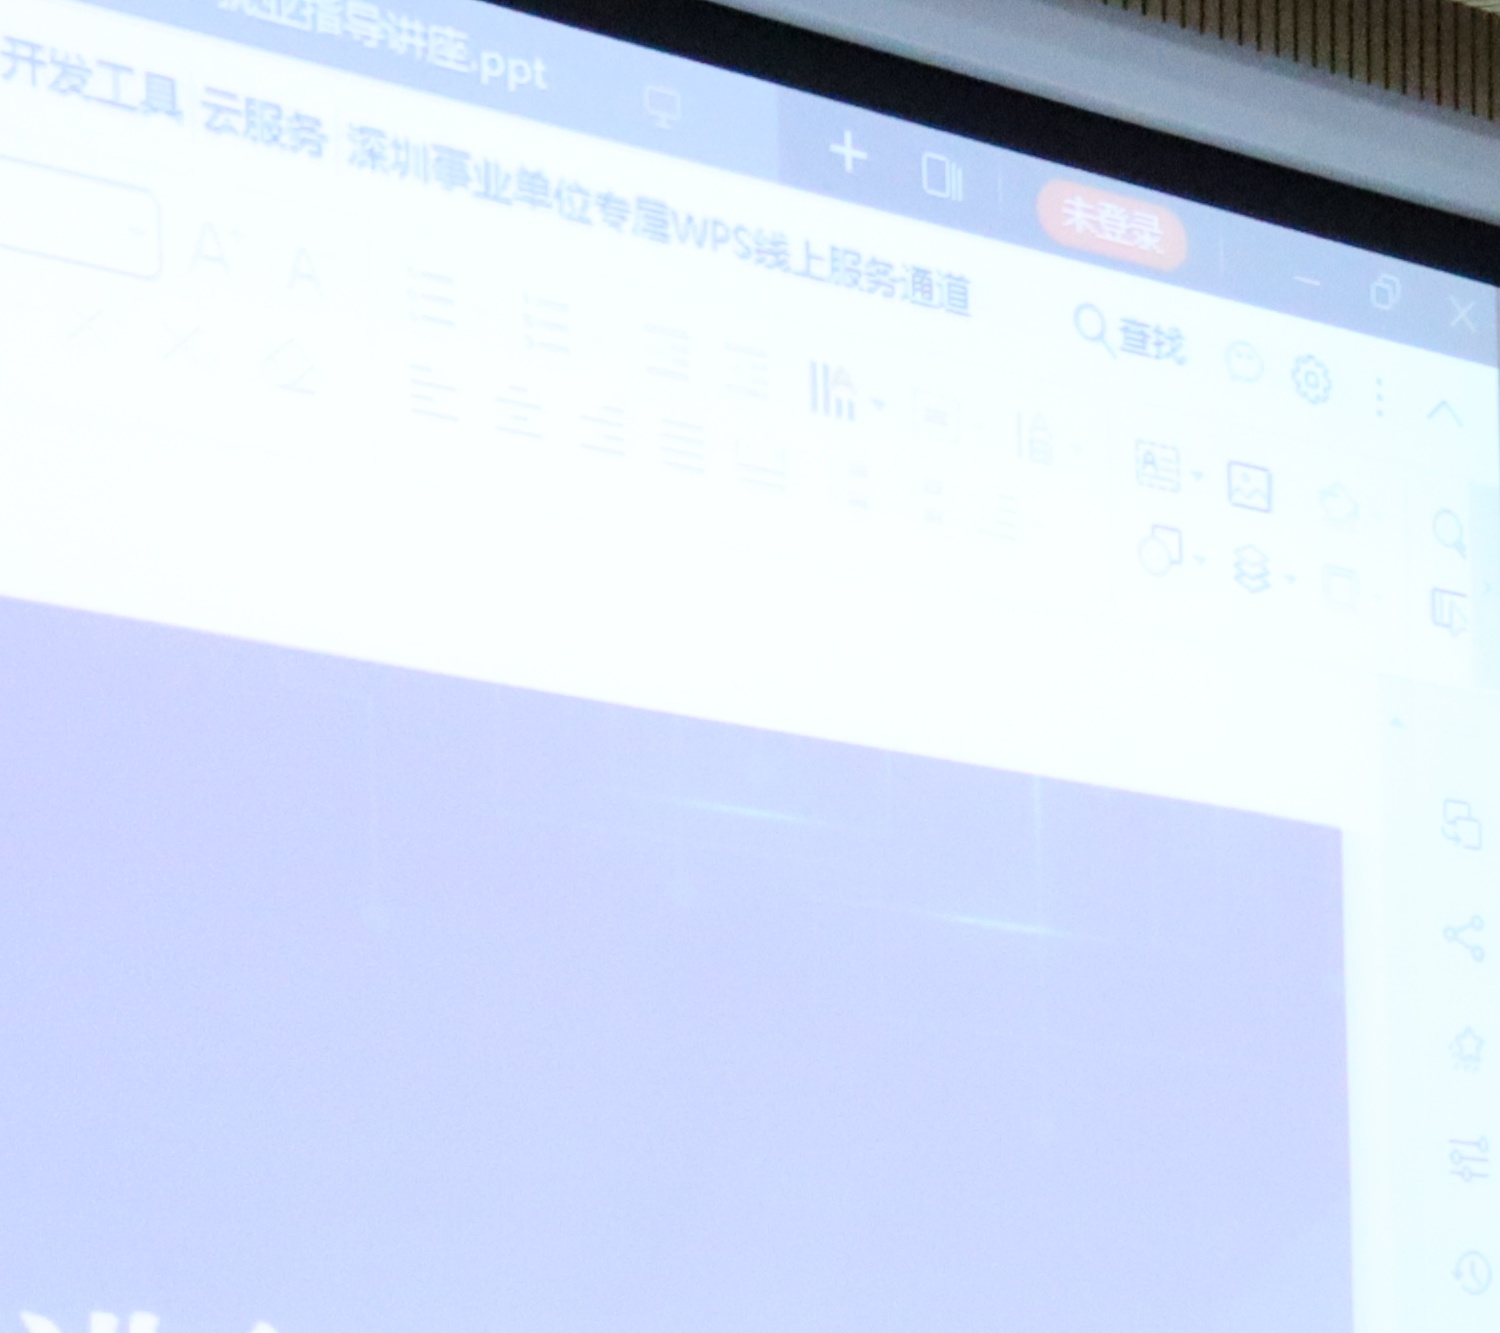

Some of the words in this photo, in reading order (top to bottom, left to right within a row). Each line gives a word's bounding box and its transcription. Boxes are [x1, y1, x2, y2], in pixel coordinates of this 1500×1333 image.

[0, 36, 184, 124] 开发工具
[202, 85, 330, 159] 云服务
[1062, 195, 1164, 256] 未登录
[1118, 316, 1188, 367] 查找
